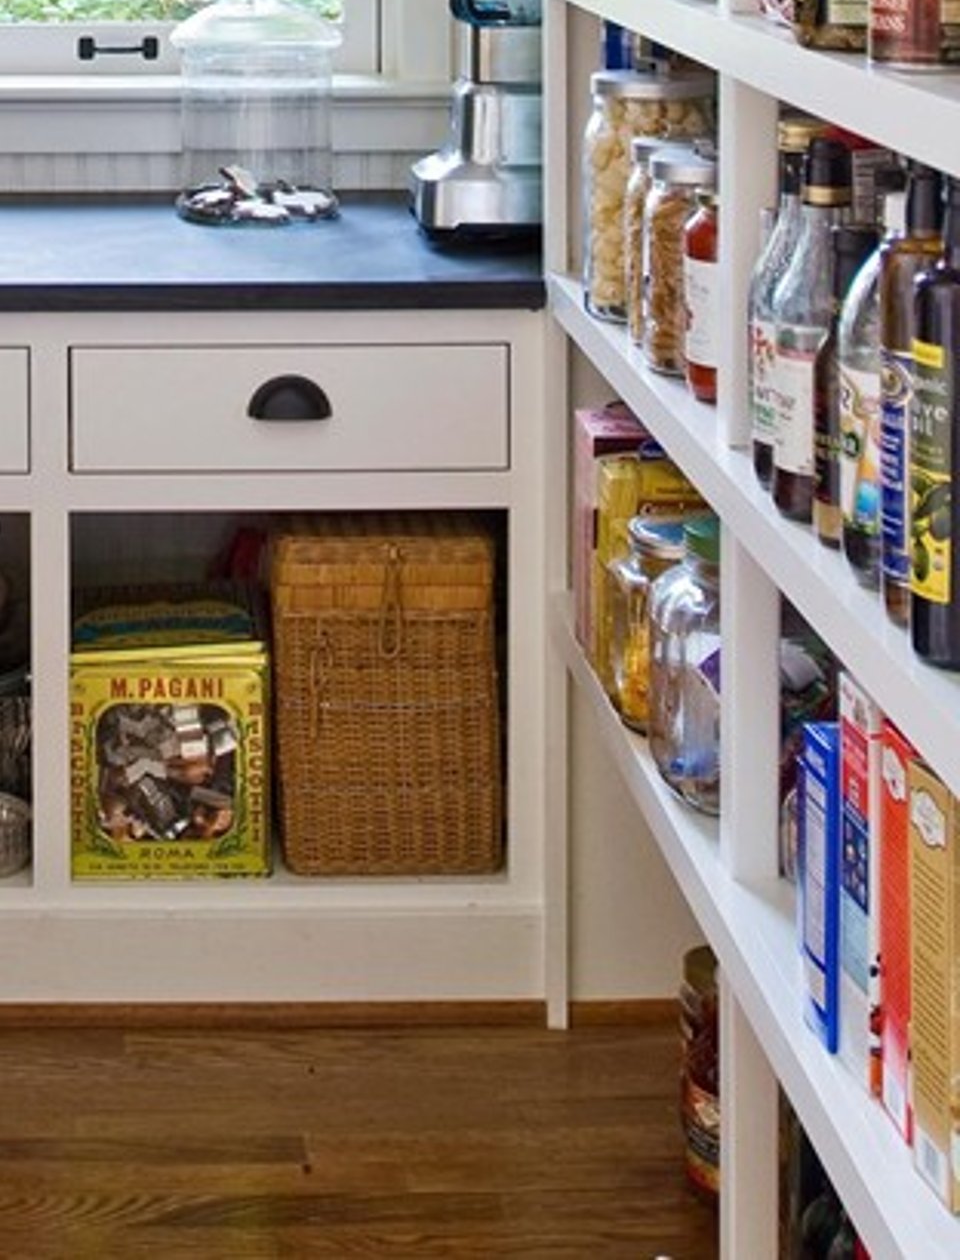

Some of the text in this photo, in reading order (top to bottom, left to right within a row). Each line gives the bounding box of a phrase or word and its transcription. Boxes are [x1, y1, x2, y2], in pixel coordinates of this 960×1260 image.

[110, 677, 224, 699] M. PAGANI
[71, 702, 84, 842] BISCOTTI
[248, 702, 263, 842] BISCOTTI
[140, 847, 195, 860] ROMA
